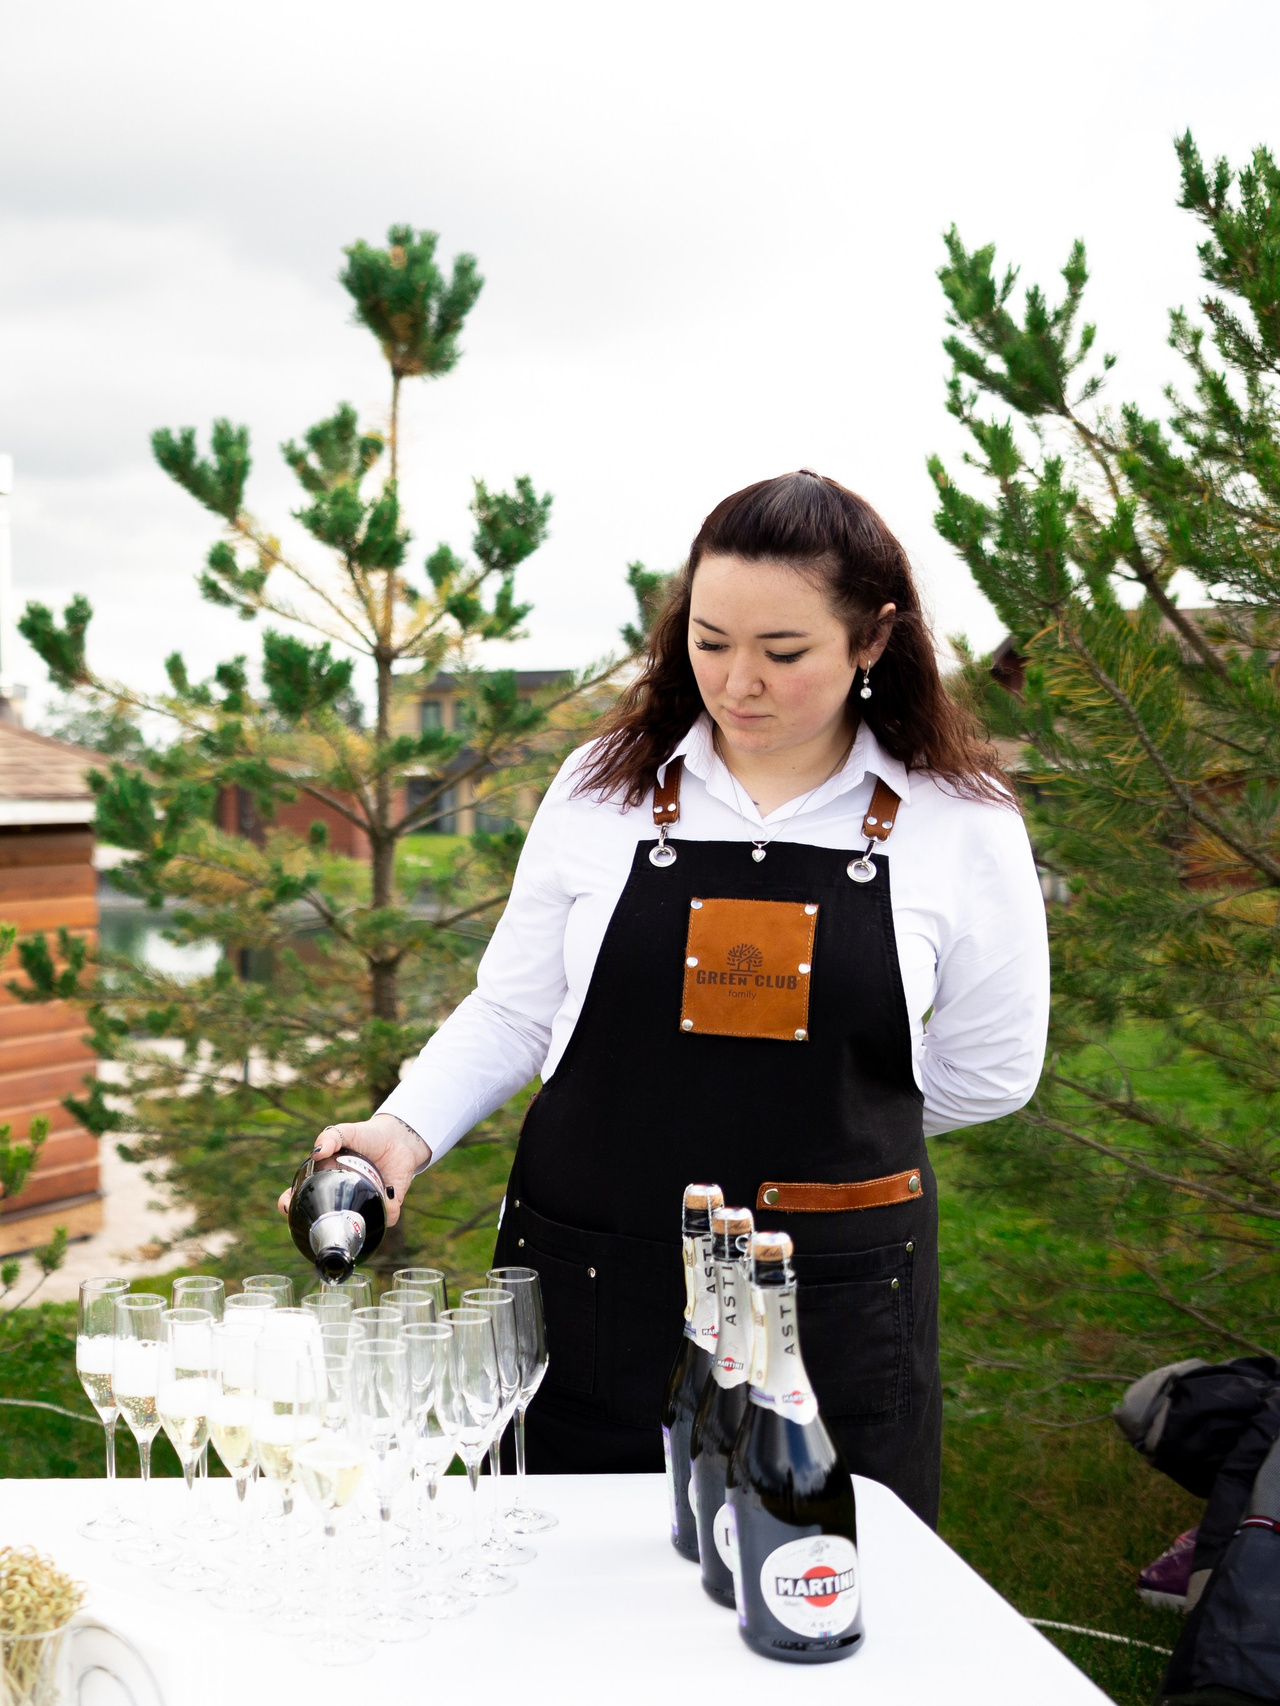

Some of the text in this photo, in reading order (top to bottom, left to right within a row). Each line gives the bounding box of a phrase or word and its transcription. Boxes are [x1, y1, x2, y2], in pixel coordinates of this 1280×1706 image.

[696, 970, 797, 990] GREEN CLUB
[728, 989, 757, 1000] family
[722, 1266, 737, 1326] ASTI
[778, 1292, 796, 1356] ASTI
[717, 1359, 744, 1370] MARTINI
[776, 1569, 854, 1597] MARTINI
